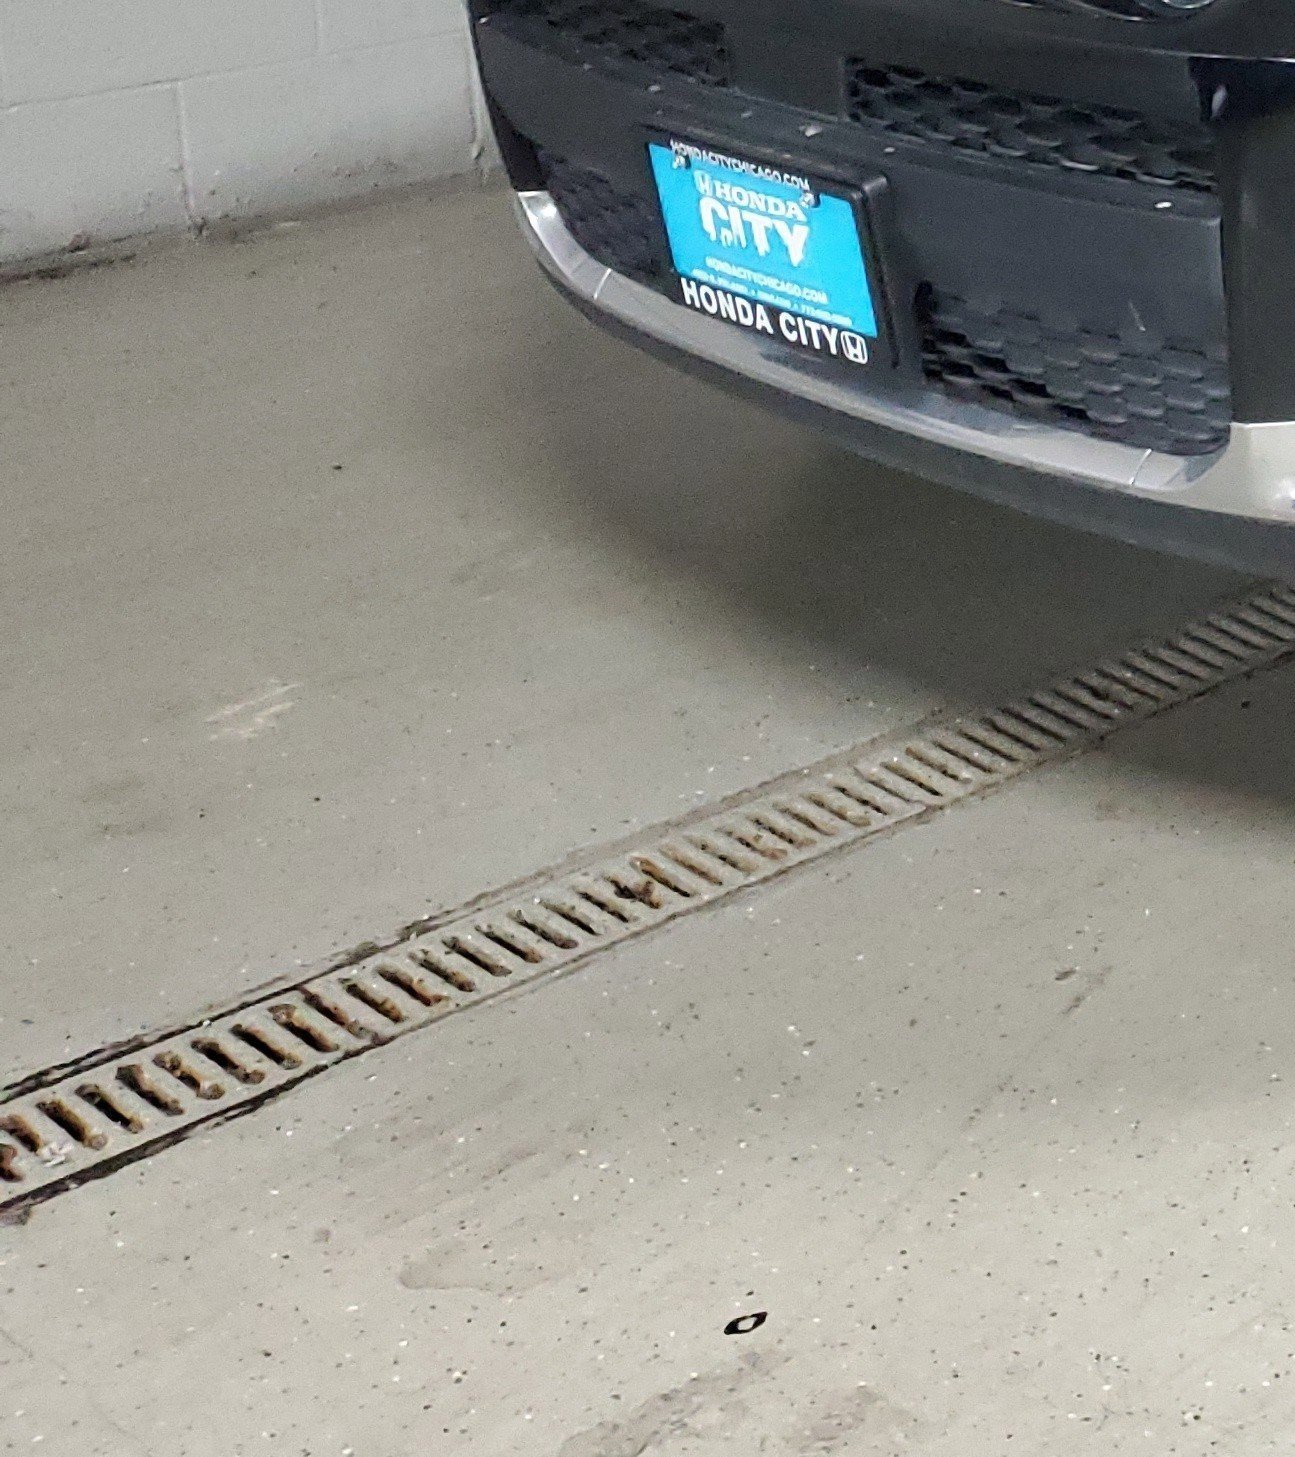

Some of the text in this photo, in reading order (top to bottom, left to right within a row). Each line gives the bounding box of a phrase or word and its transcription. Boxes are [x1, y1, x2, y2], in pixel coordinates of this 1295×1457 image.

[699, 196, 810, 267] CITY
[714, 180, 808, 222] HONDA
[680, 277, 775, 335] HONDA
[778, 311, 839, 355] CITY
